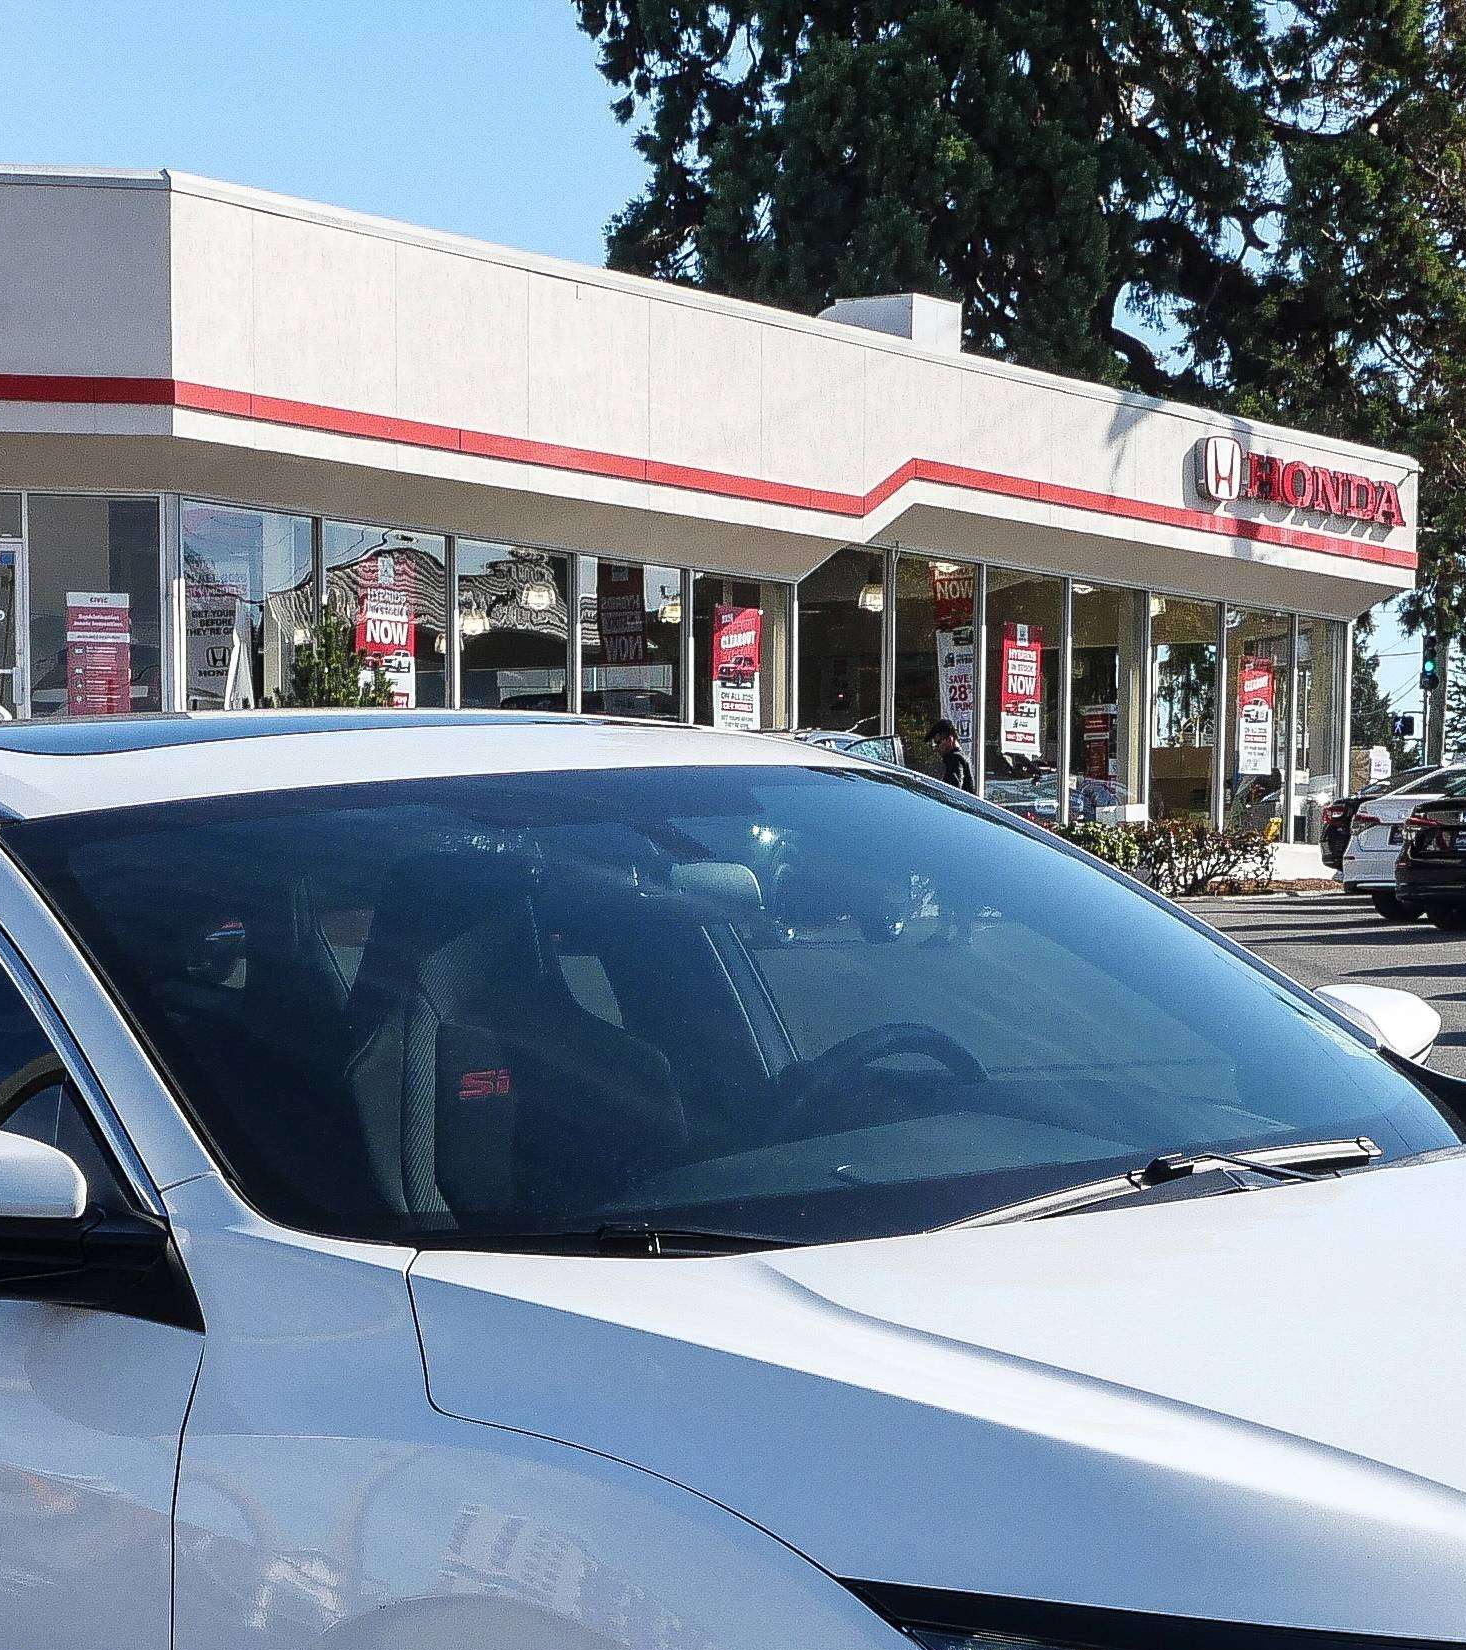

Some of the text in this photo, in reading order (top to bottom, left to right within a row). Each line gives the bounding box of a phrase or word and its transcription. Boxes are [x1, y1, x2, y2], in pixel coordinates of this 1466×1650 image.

[1247, 451, 1406, 527] HONDA
[365, 619, 409, 646] NOW
[197, 669, 228, 678] HON
[1007, 673, 1037, 696] NOW
